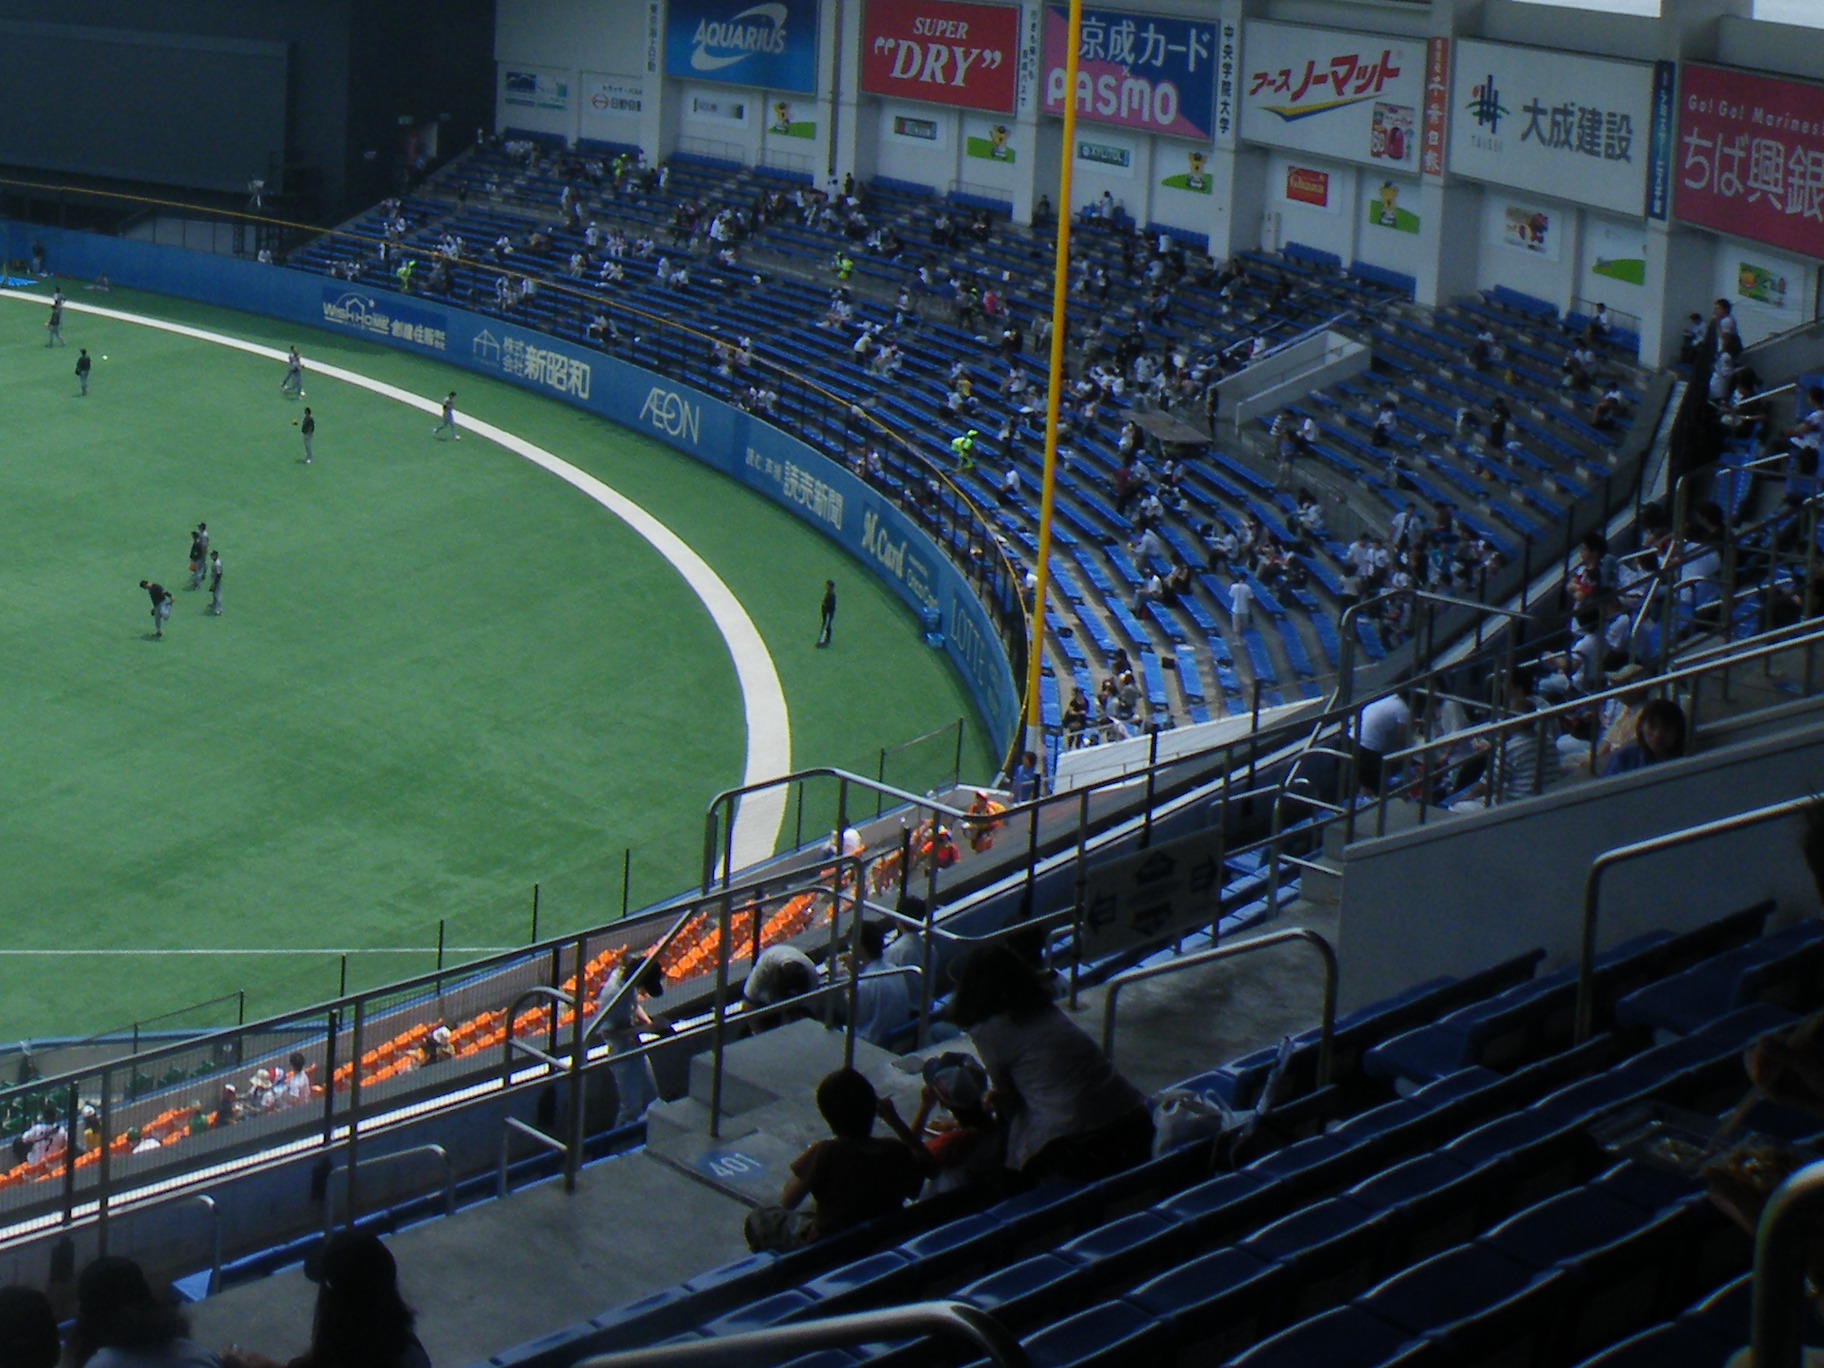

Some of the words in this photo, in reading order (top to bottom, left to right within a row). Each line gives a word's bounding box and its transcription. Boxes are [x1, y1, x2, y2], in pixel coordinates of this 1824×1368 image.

[692, 17, 787, 54] AQUARIUS
[913, 16, 969, 39] SUPER
[1079, 16, 1211, 72] 京成カード
[1046, 67, 1178, 126] PASMO
[1687, 93, 1713, 114] Go!
[1718, 99, 1744, 121] Go!
[1520, 97, 1633, 164] 大成建設
[1682, 126, 1824, 224] ちば興銀
[525, 345, 591, 401] 新昭和
[783, 459, 844, 531] 読売新聞
[709, 1152, 762, 1177] 401
